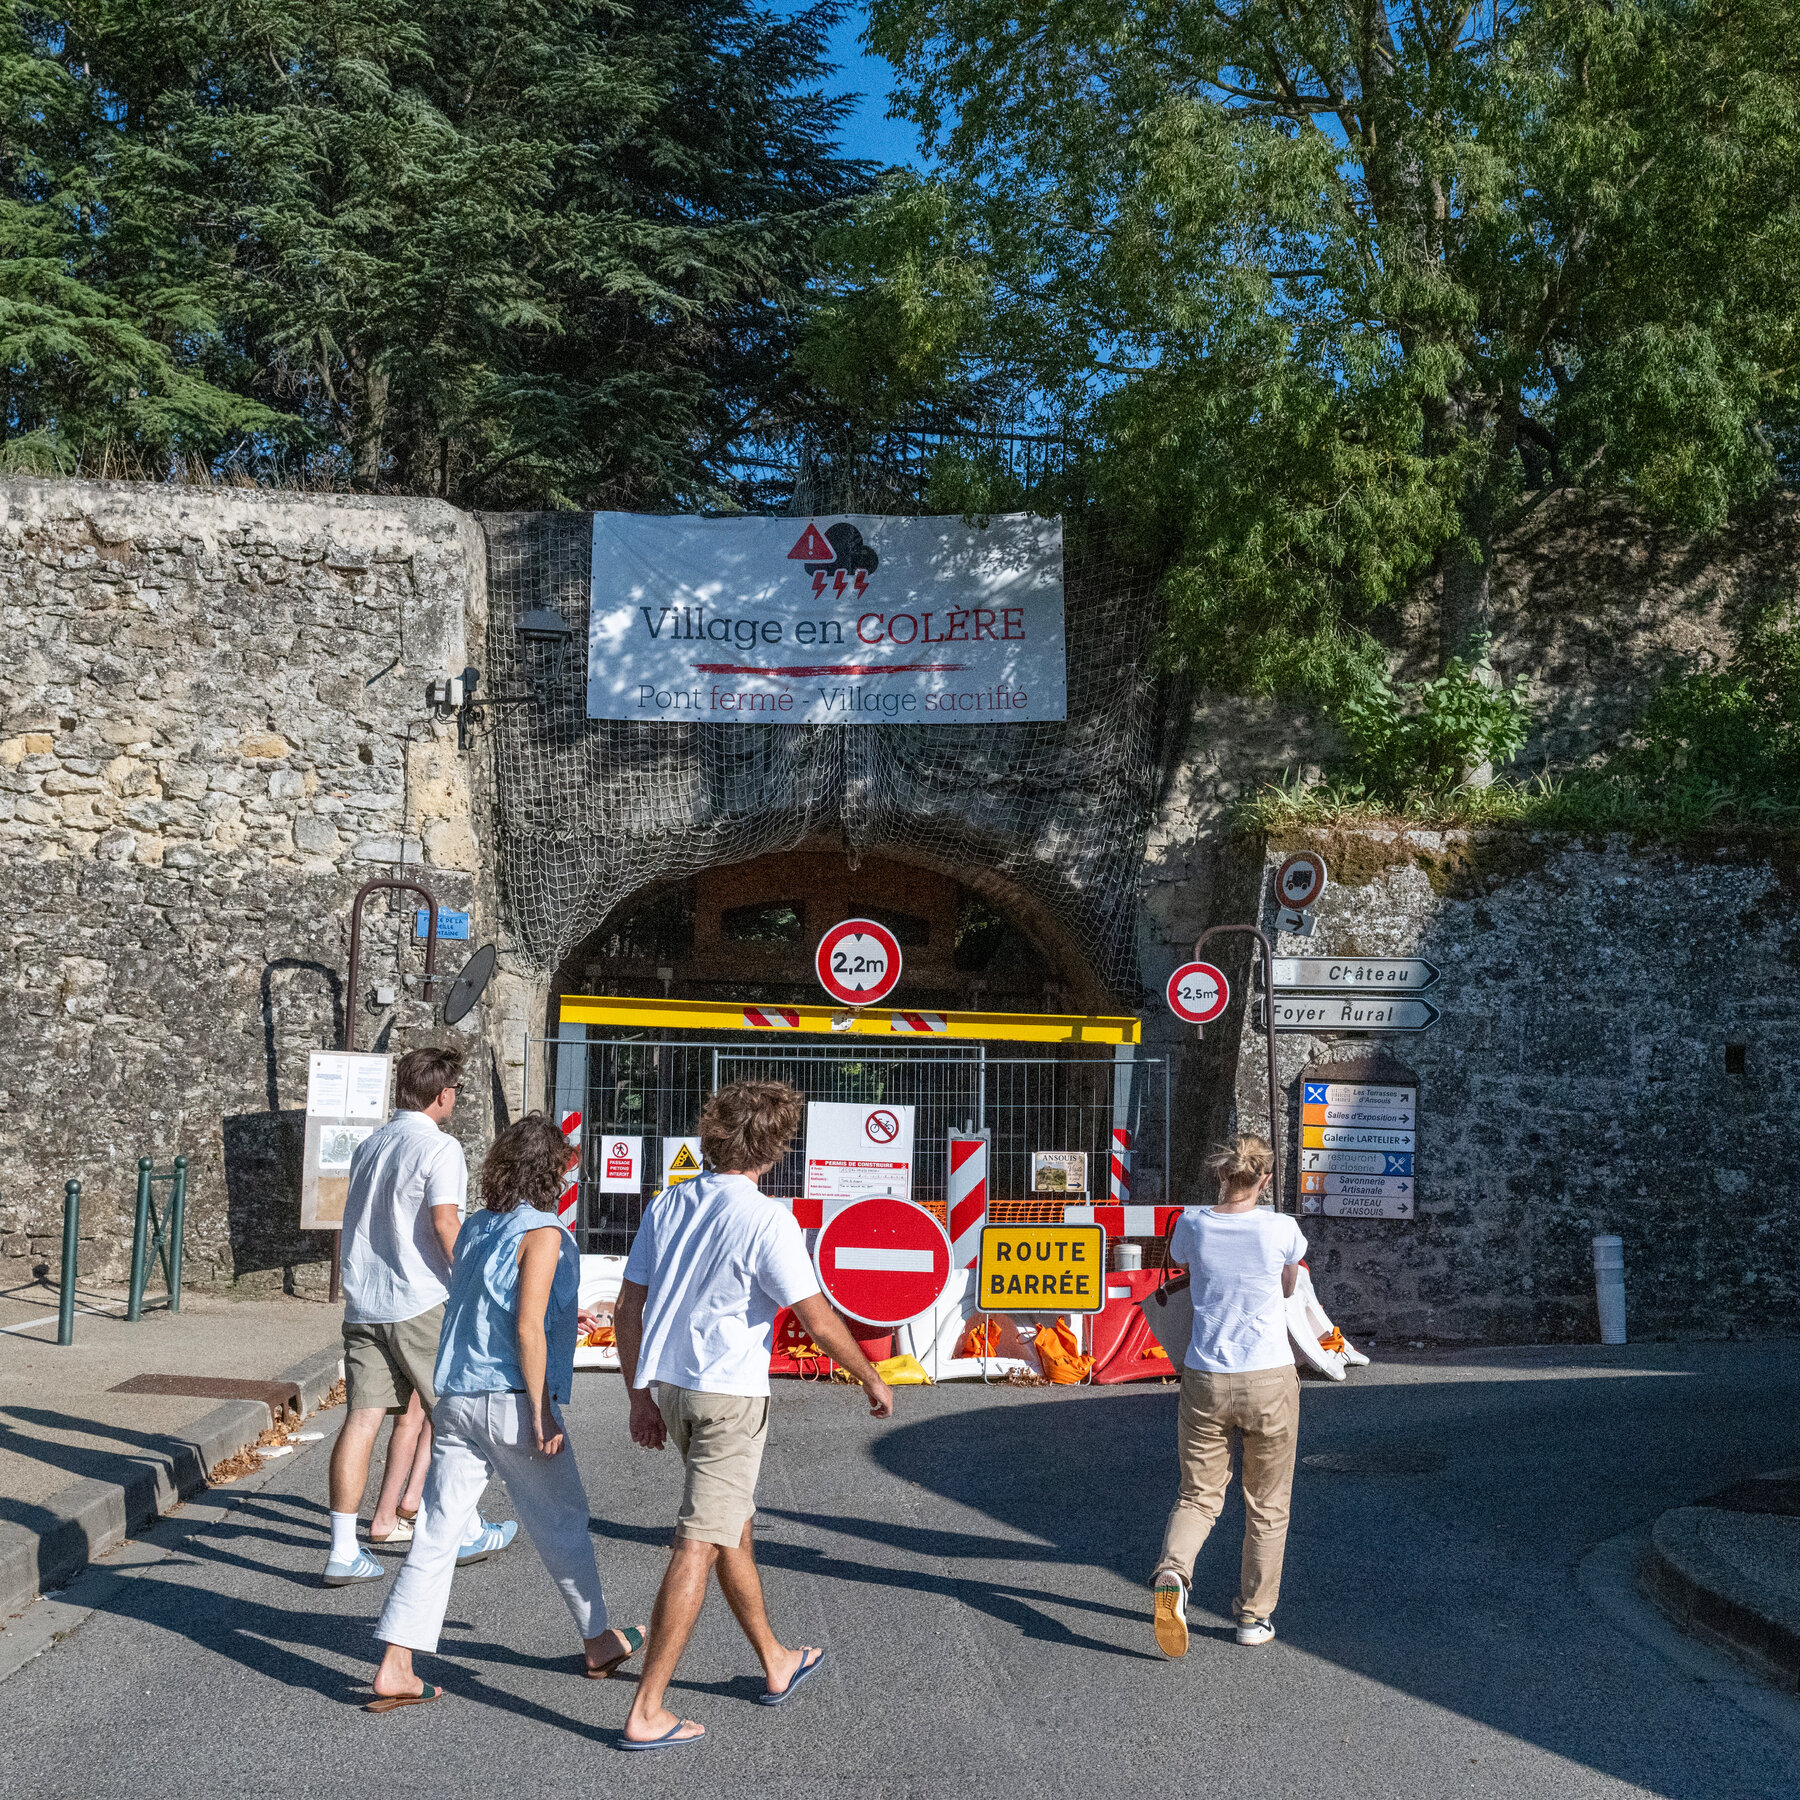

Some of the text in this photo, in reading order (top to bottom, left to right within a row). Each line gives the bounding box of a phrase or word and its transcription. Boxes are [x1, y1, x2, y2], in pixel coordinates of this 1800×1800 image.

[640, 604, 1026, 651] Village en COLÈRE
[638, 685, 702, 711] Pont
[710, 686, 793, 712] fermé
[820, 687, 917, 717] Village
[925, 684, 1028, 712] sacrifié
[833, 952, 884, 975] 2,2m
[1182, 986, 1214, 1001] 2,5m
[1341, 1006, 1393, 1022] Rural
[1366, 1089, 1398, 1098] Terrasses
[1359, 1097, 1392, 1105] d'Ansouis
[1327, 1111, 1397, 1122] Salles d'Exposition
[1324, 1133, 1400, 1144] Galerie LARTELIER
[1043, 1154, 1077, 1162] ANSOUIS
[1327, 1153, 1377, 1163] restaurant
[1328, 1162, 1375, 1173] la closerie
[1339, 1176, 1386, 1186] Savonnerie
[1341, 1185, 1383, 1195] Artisanale
[1342, 1197, 1382, 1207] CHATEAU
[1339, 1207, 1384, 1216] d'ANSOUIS
[996, 1241, 1086, 1263] ROUTE
[990, 1269, 1090, 1296] BARRÉE
